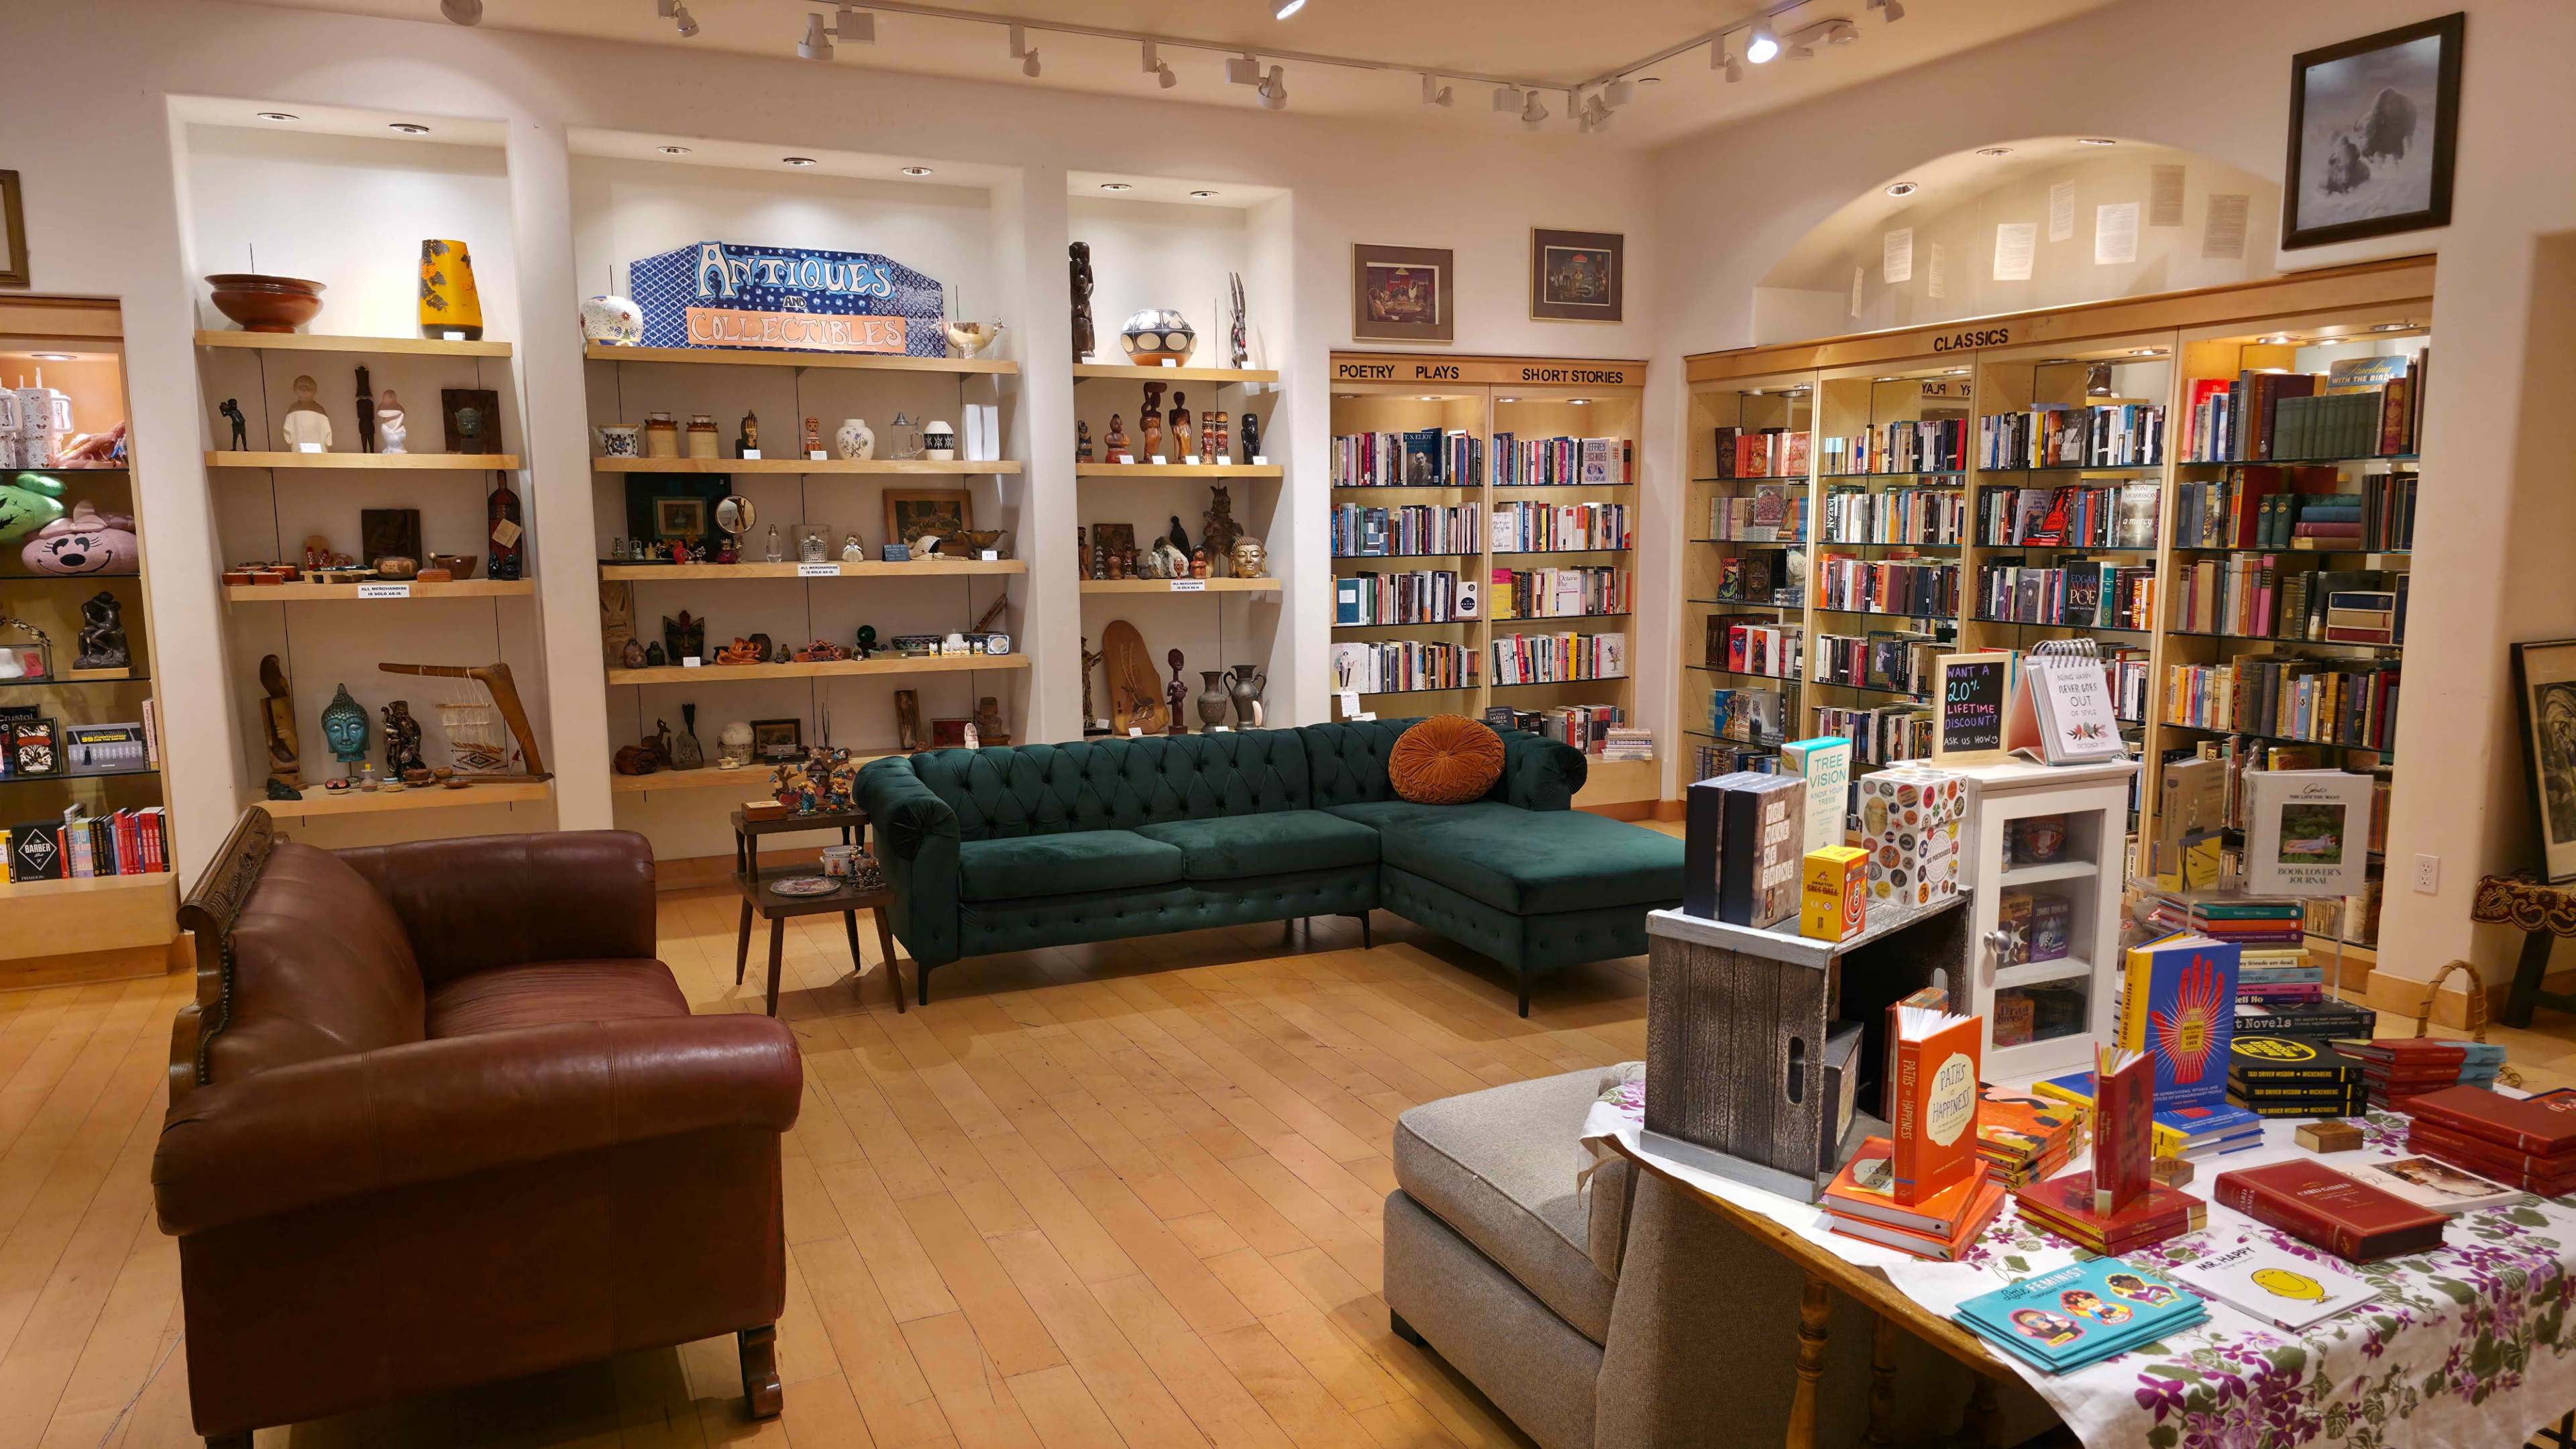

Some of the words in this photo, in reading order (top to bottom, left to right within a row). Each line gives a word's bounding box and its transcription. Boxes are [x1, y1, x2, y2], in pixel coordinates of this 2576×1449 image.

[783, 296, 806, 307] AND
[690, 311, 903, 346] COLLECTIBLES
[1934, 328, 2008, 352] CLASSICS
[1339, 364, 1395, 378] POETRY
[1415, 366, 1459, 379] PLAYS
[1522, 368, 1568, 382] SHORT
[1571, 370, 1623, 384] STORIES
[2369, 373, 2395, 381] BIRDS
[1587, 443, 1605, 451] JEFFREY
[1827, 498, 1835, 528] TARZAN
[2129, 519, 2153, 527] mercy
[2071, 575, 2097, 583] EDGAR
[2071, 582, 2096, 590] ALLAN
[2070, 589, 2097, 605] POE
[1947, 666, 1976, 678] WANT
[1981, 664, 1990, 676] A
[2072, 673, 2092, 681] HAPPY
[1947, 679, 1980, 702] 20%
[2059, 684, 2080, 694] NEVER
[2080, 682, 2098, 693] GOES
[2070, 695, 2092, 707] OUT
[1947, 704, 1995, 714] LIFETIME
[2081, 708, 2098, 716] STYLE
[1945, 714, 1998, 731] DISCOUNT?
[1943, 738, 1959, 746] ASK
[1961, 737, 1972, 746] US
[1974, 736, 1991, 745] HOW
[1815, 753, 1843, 771] TREE
[1809, 768, 1846, 788] VISION
[1811, 791, 1827, 799] KNOW
[1829, 786, 1844, 794] YOUR
[1818, 796, 1836, 805] TREES
[1767, 807, 1784, 818] YOU
[1765, 825, 1788, 841] MAKE
[24, 843, 51, 853] BARBER
[1933, 848, 1951, 861] POSTCARDS
[1765, 851, 1776, 863] ME
[1763, 863, 1793, 885] SHINE
[2305, 868, 2341, 876] LOVER'S
[2290, 877, 2327, 885] JOURNAL
[2125, 982, 2133, 1010] RECIPES
[2245, 1017, 2292, 1028] Novels
[1902, 1059, 1916, 1087] PATHS
[1940, 1063, 1966, 1091] PATHS
[1932, 1086, 1971, 1124] HAPPINESS
[1901, 1100, 1916, 1140] HAPPINESS
[2297, 1187, 2321, 1196] CARD
[2321, 1183, 2351, 1193] GAMES
[2239, 1189, 2247, 1210] CARD
[2195, 1260, 2222, 1271] MR.
[2216, 1246, 2256, 1264] HAPPY
[2025, 1267, 2087, 1293] FEMINIST
[2001, 1287, 2031, 1301] Little
[2029, 1286, 2058, 1300] TEMPORARY
